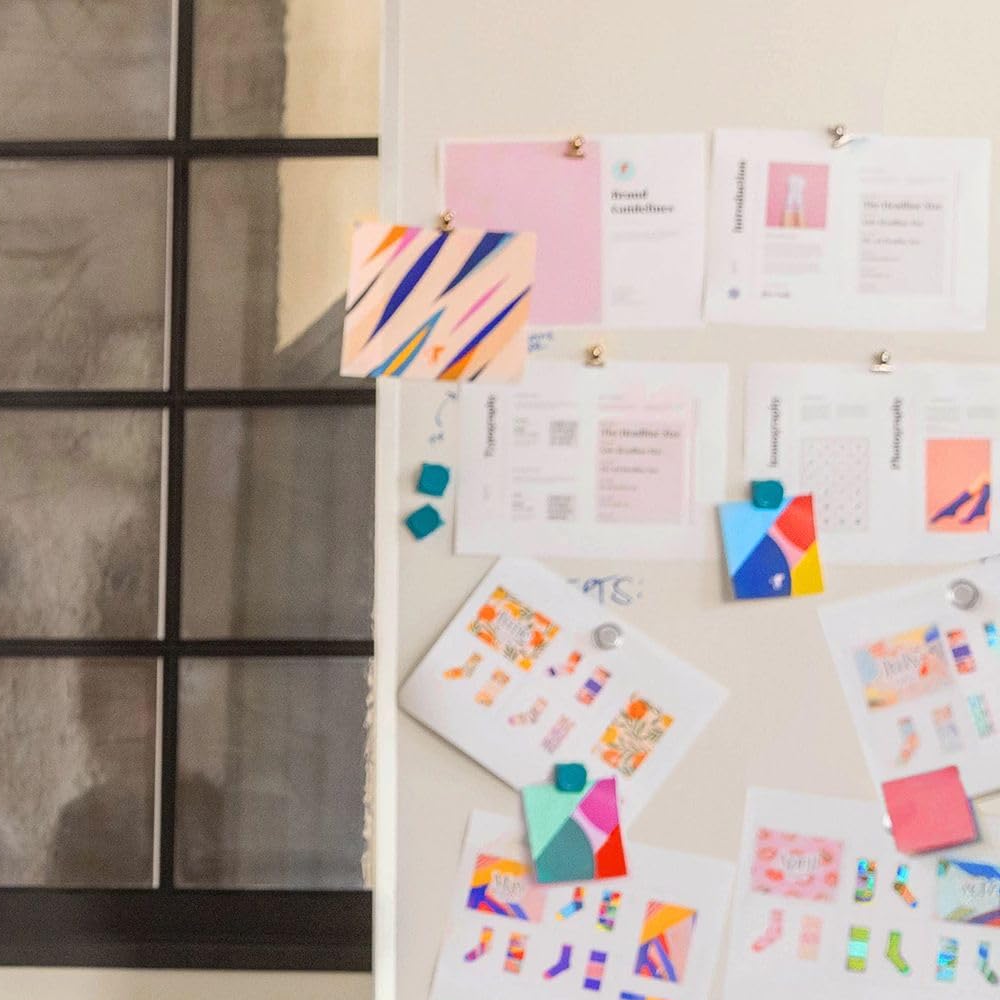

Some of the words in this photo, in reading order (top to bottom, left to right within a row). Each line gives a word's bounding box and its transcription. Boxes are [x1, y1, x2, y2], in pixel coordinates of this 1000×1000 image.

[610, 189, 647, 200] Brand
[610, 204, 674, 216] Guidelines
[889, 396, 903, 470] Photography
